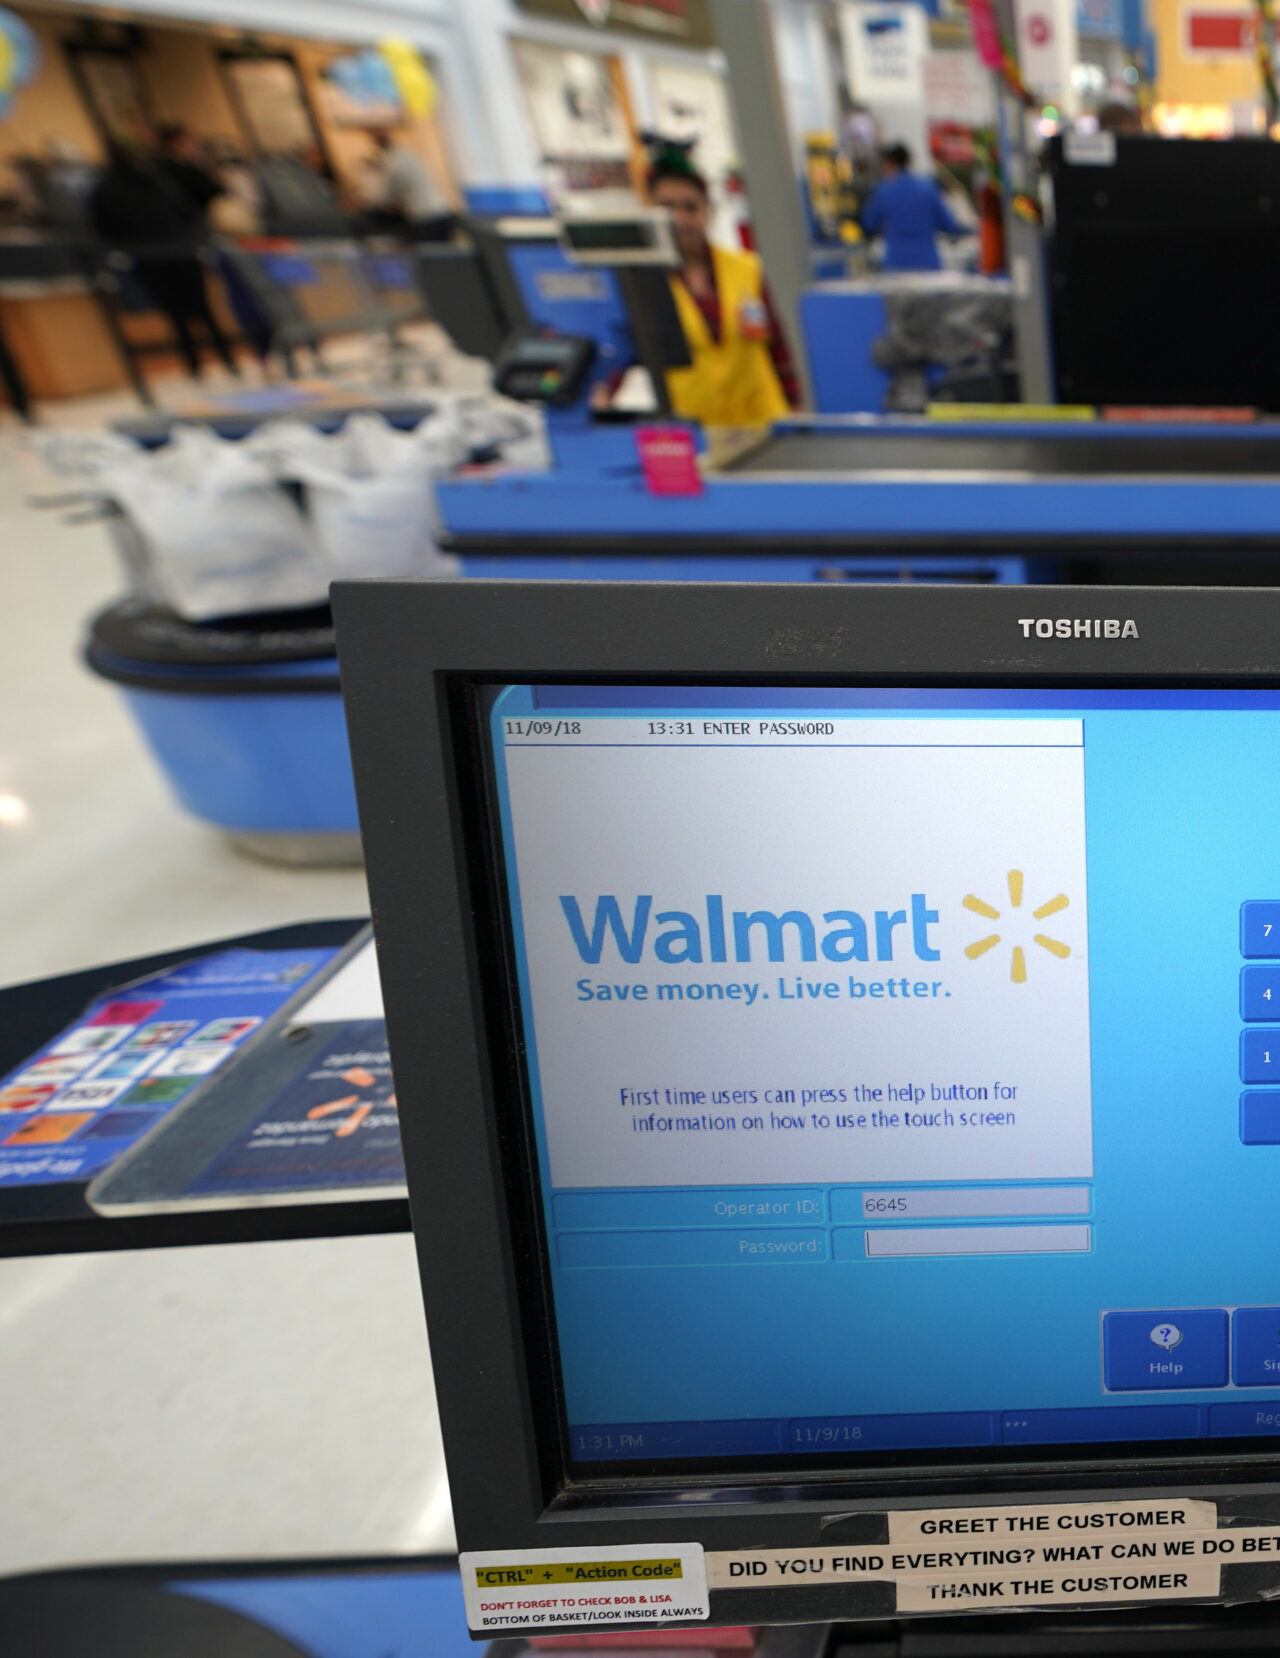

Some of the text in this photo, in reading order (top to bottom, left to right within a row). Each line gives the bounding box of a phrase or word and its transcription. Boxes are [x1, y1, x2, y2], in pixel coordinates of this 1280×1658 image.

[1018, 619, 1140, 639] TOSHIBA
[505, 721, 834, 737] 11/09/18 13:31 ENTER PASSWORD
[559, 893, 940, 964] Walmart
[1263, 925, 1272, 937] 7
[577, 975, 952, 1006] Save money. Live better.
[1262, 989, 1272, 1001] 4
[1263, 1051, 1271, 1063] 1
[620, 1081, 1018, 1107] First time users can press the help button for
[632, 1108, 1016, 1132] information on how to use the touch screen
[714, 1199, 820, 1218] Operator ID:
[865, 1198, 908, 1212] 6645
[738, 1238, 822, 1254] Password:
[1149, 1361, 1183, 1376] Help
[577, 1433, 643, 1450] 1:31 PM
[794, 1425, 862, 1442] 11/9/18
[920, 1509, 1186, 1536] GREET THE CUSTOMER
[729, 1560, 768, 1578] DID
[774, 1557, 824, 1575] YOU
[832, 1555, 884, 1573] FIND
[891, 1548, 1036, 1570] EVERYTING?
[1042, 1545, 1105, 1563] WHAT
[1110, 1542, 1158, 1559] CAN
[1163, 1540, 1196, 1556] WE
[1202, 1537, 1236, 1555] DO
[476, 1568, 533, 1584] "CTRL"
[566, 1565, 628, 1580] "Action
[632, 1562, 681, 1577] Code"
[926, 1573, 1189, 1600] THANK THE CUSTOMER
[480, 1594, 672, 1612] DON'T FORGET TO CHECK BOB & LISA
[482, 1607, 704, 1626] BOTTOM OF BASKET/LOOK INSIDE ALWAYS
